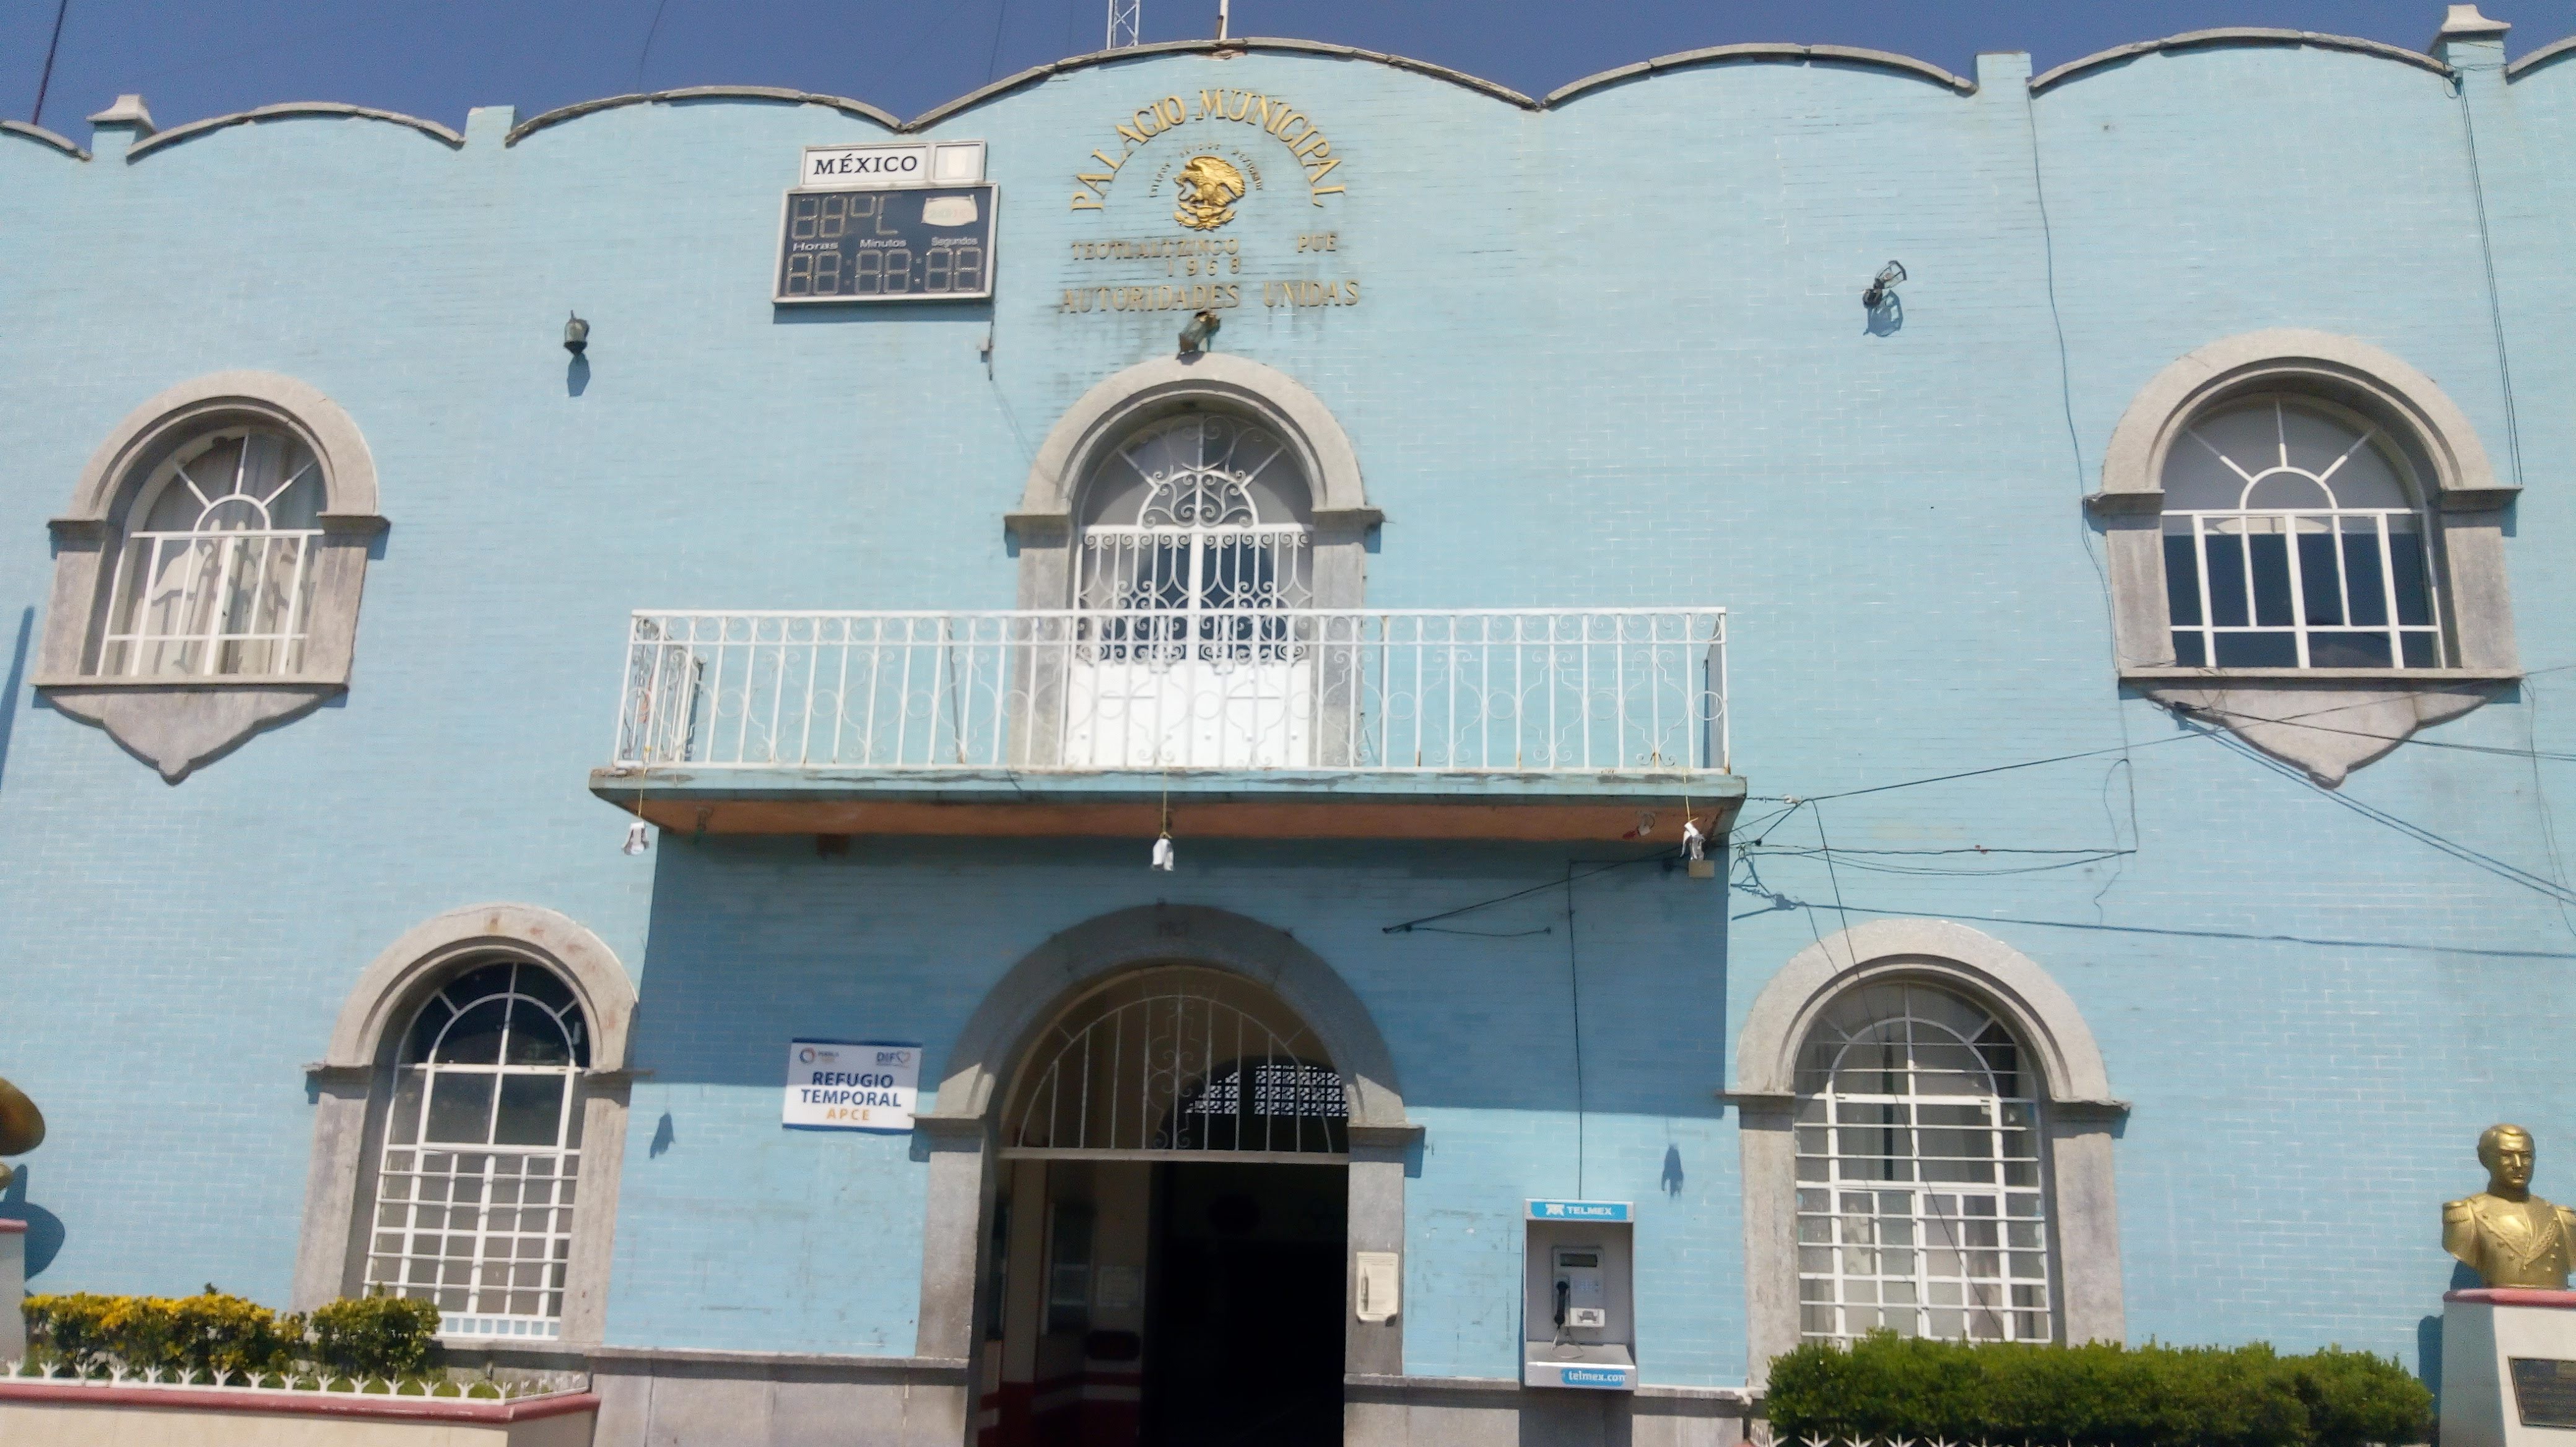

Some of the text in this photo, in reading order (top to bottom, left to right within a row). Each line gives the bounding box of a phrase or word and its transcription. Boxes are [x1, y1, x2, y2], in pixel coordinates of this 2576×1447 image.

[1069, 89, 1346, 212] PALACIO MUNICIPAL
[812, 153, 918, 175] MÉXICO
[793, 236, 978, 251] Horas Minutos Segundos
[1166, 256, 1240, 277] 1968
[1059, 279, 1360, 313] AUTORIDADES UNIDAS
[812, 1071, 894, 1088] REFUGIO
[801, 1088, 902, 1108] TEMPORAL
[825, 1108, 870, 1121] APCE
[1567, 1205, 1612, 1216] TELMEX
